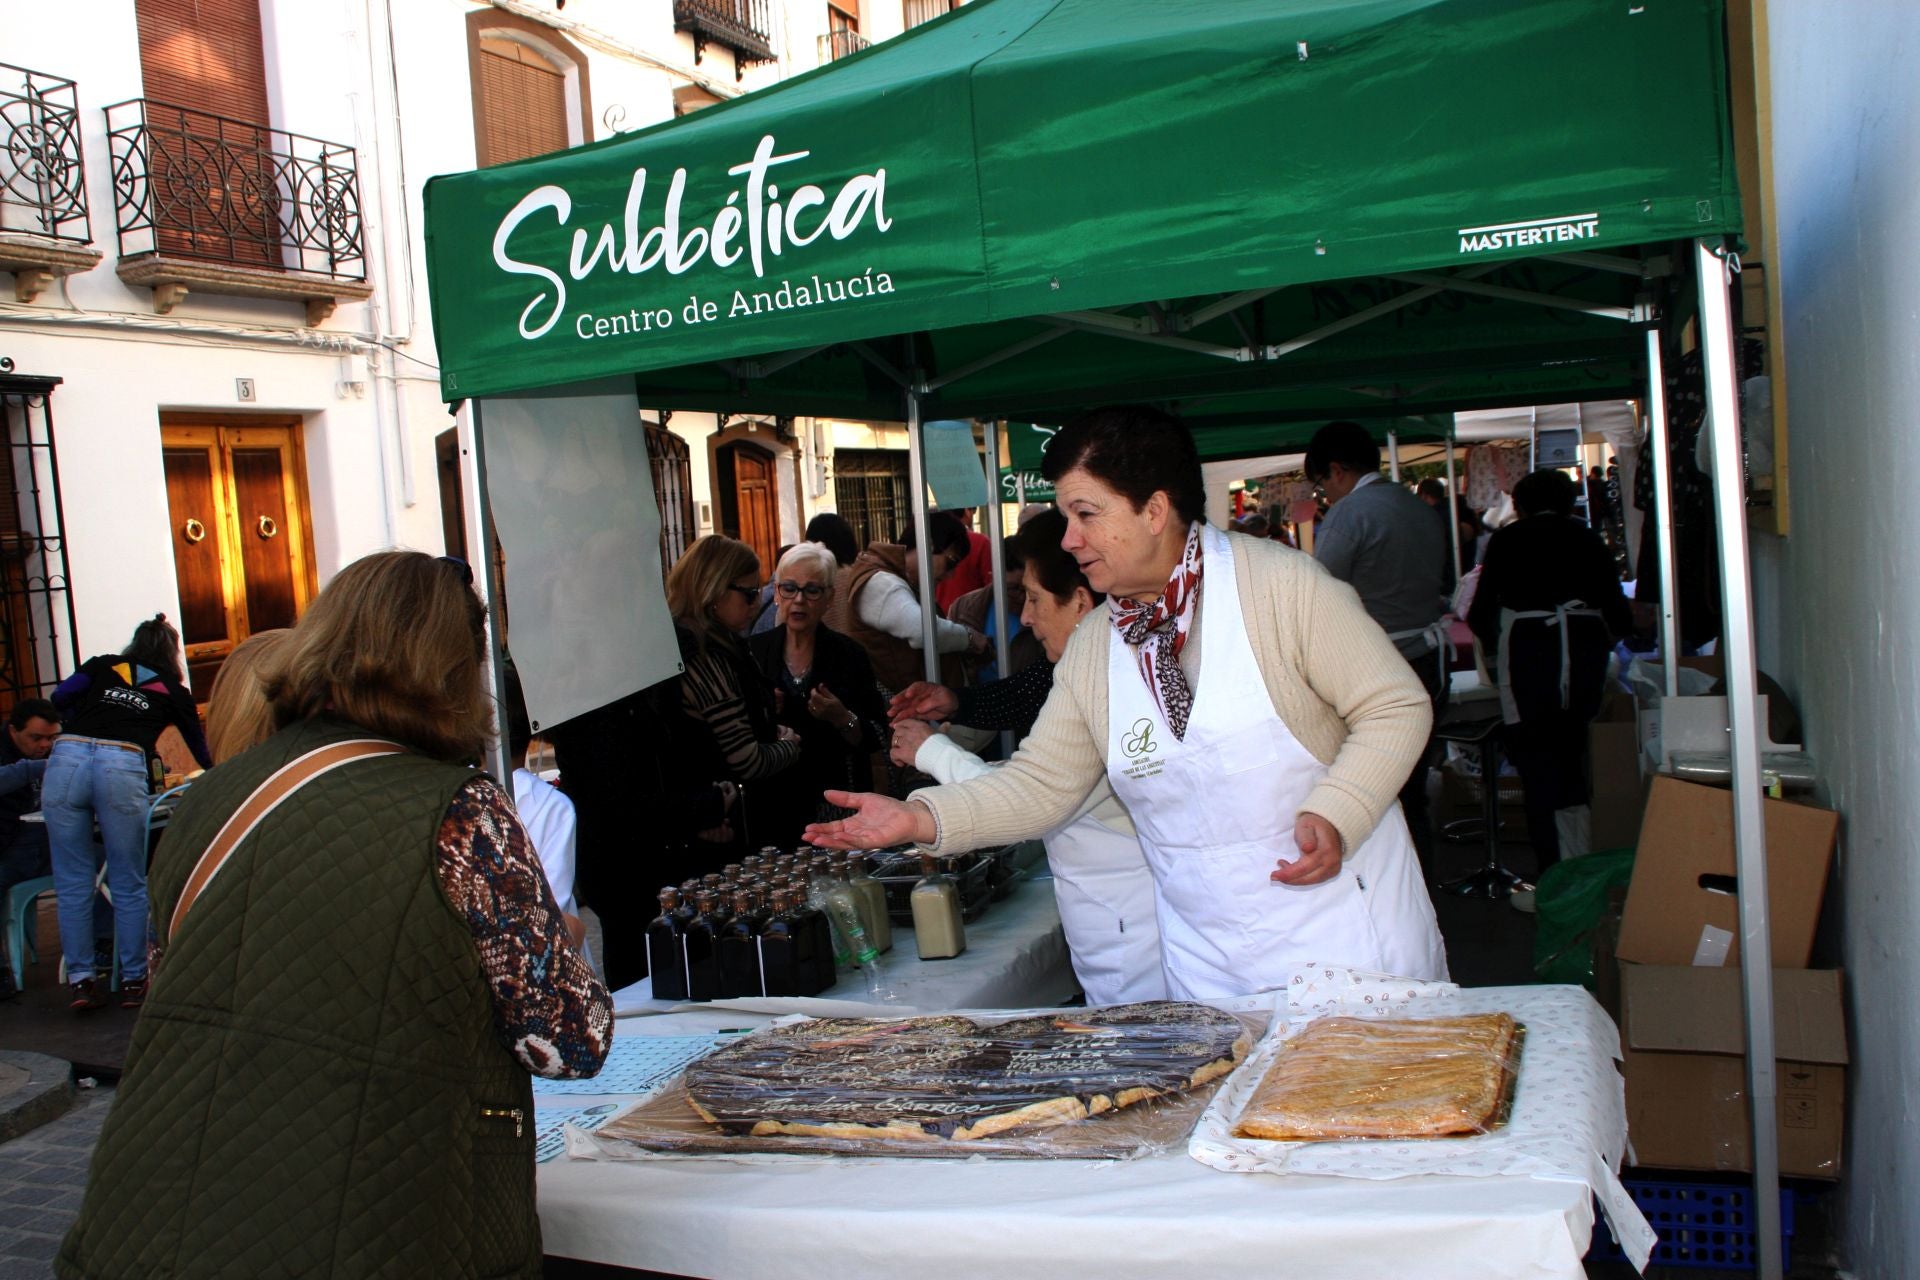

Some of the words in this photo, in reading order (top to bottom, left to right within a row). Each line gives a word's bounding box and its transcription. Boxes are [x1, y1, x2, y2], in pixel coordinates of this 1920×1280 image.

[493, 134, 892, 339] Subbética
[1459, 220, 1598, 254] MASTERTENT
[576, 308, 673, 339] Centro
[682, 296, 718, 324] de
[728, 268, 895, 317] Andalucía
[241, 381, 250, 398] 3
[104, 689, 149, 709] TEATRO
